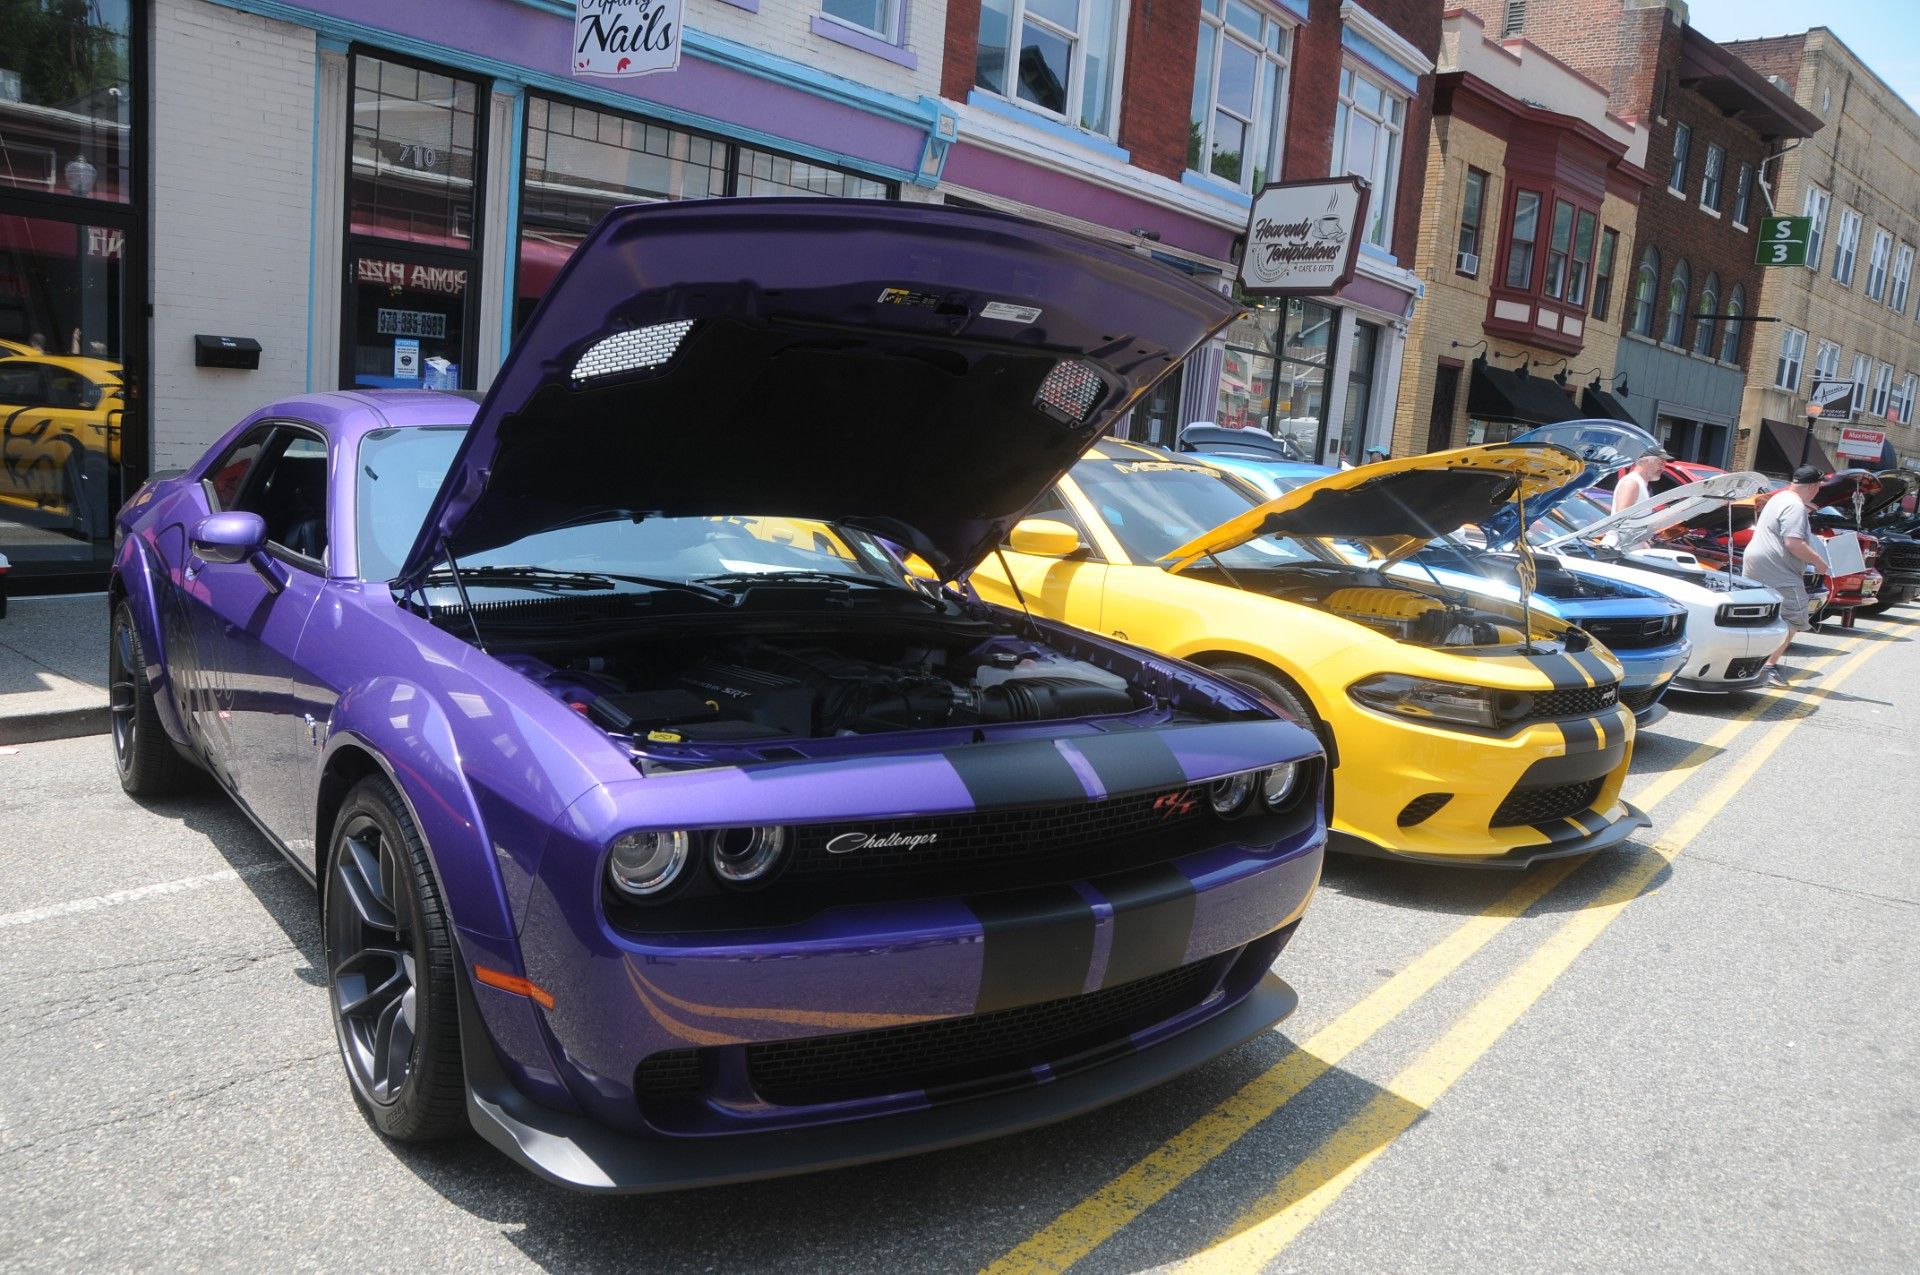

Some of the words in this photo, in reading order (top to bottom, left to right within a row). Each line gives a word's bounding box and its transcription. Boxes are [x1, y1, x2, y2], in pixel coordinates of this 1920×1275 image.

[578, 5, 675, 53] Nails
[401, 145, 436, 166] 710
[1255, 217, 1313, 241] Heavenly
[1775, 220, 1792, 239] S
[1265, 240, 1341, 265] Temptations
[1771, 244, 1788, 263] 3
[1152, 789, 1197, 820] R/T
[826, 832, 938, 853] Challenger
